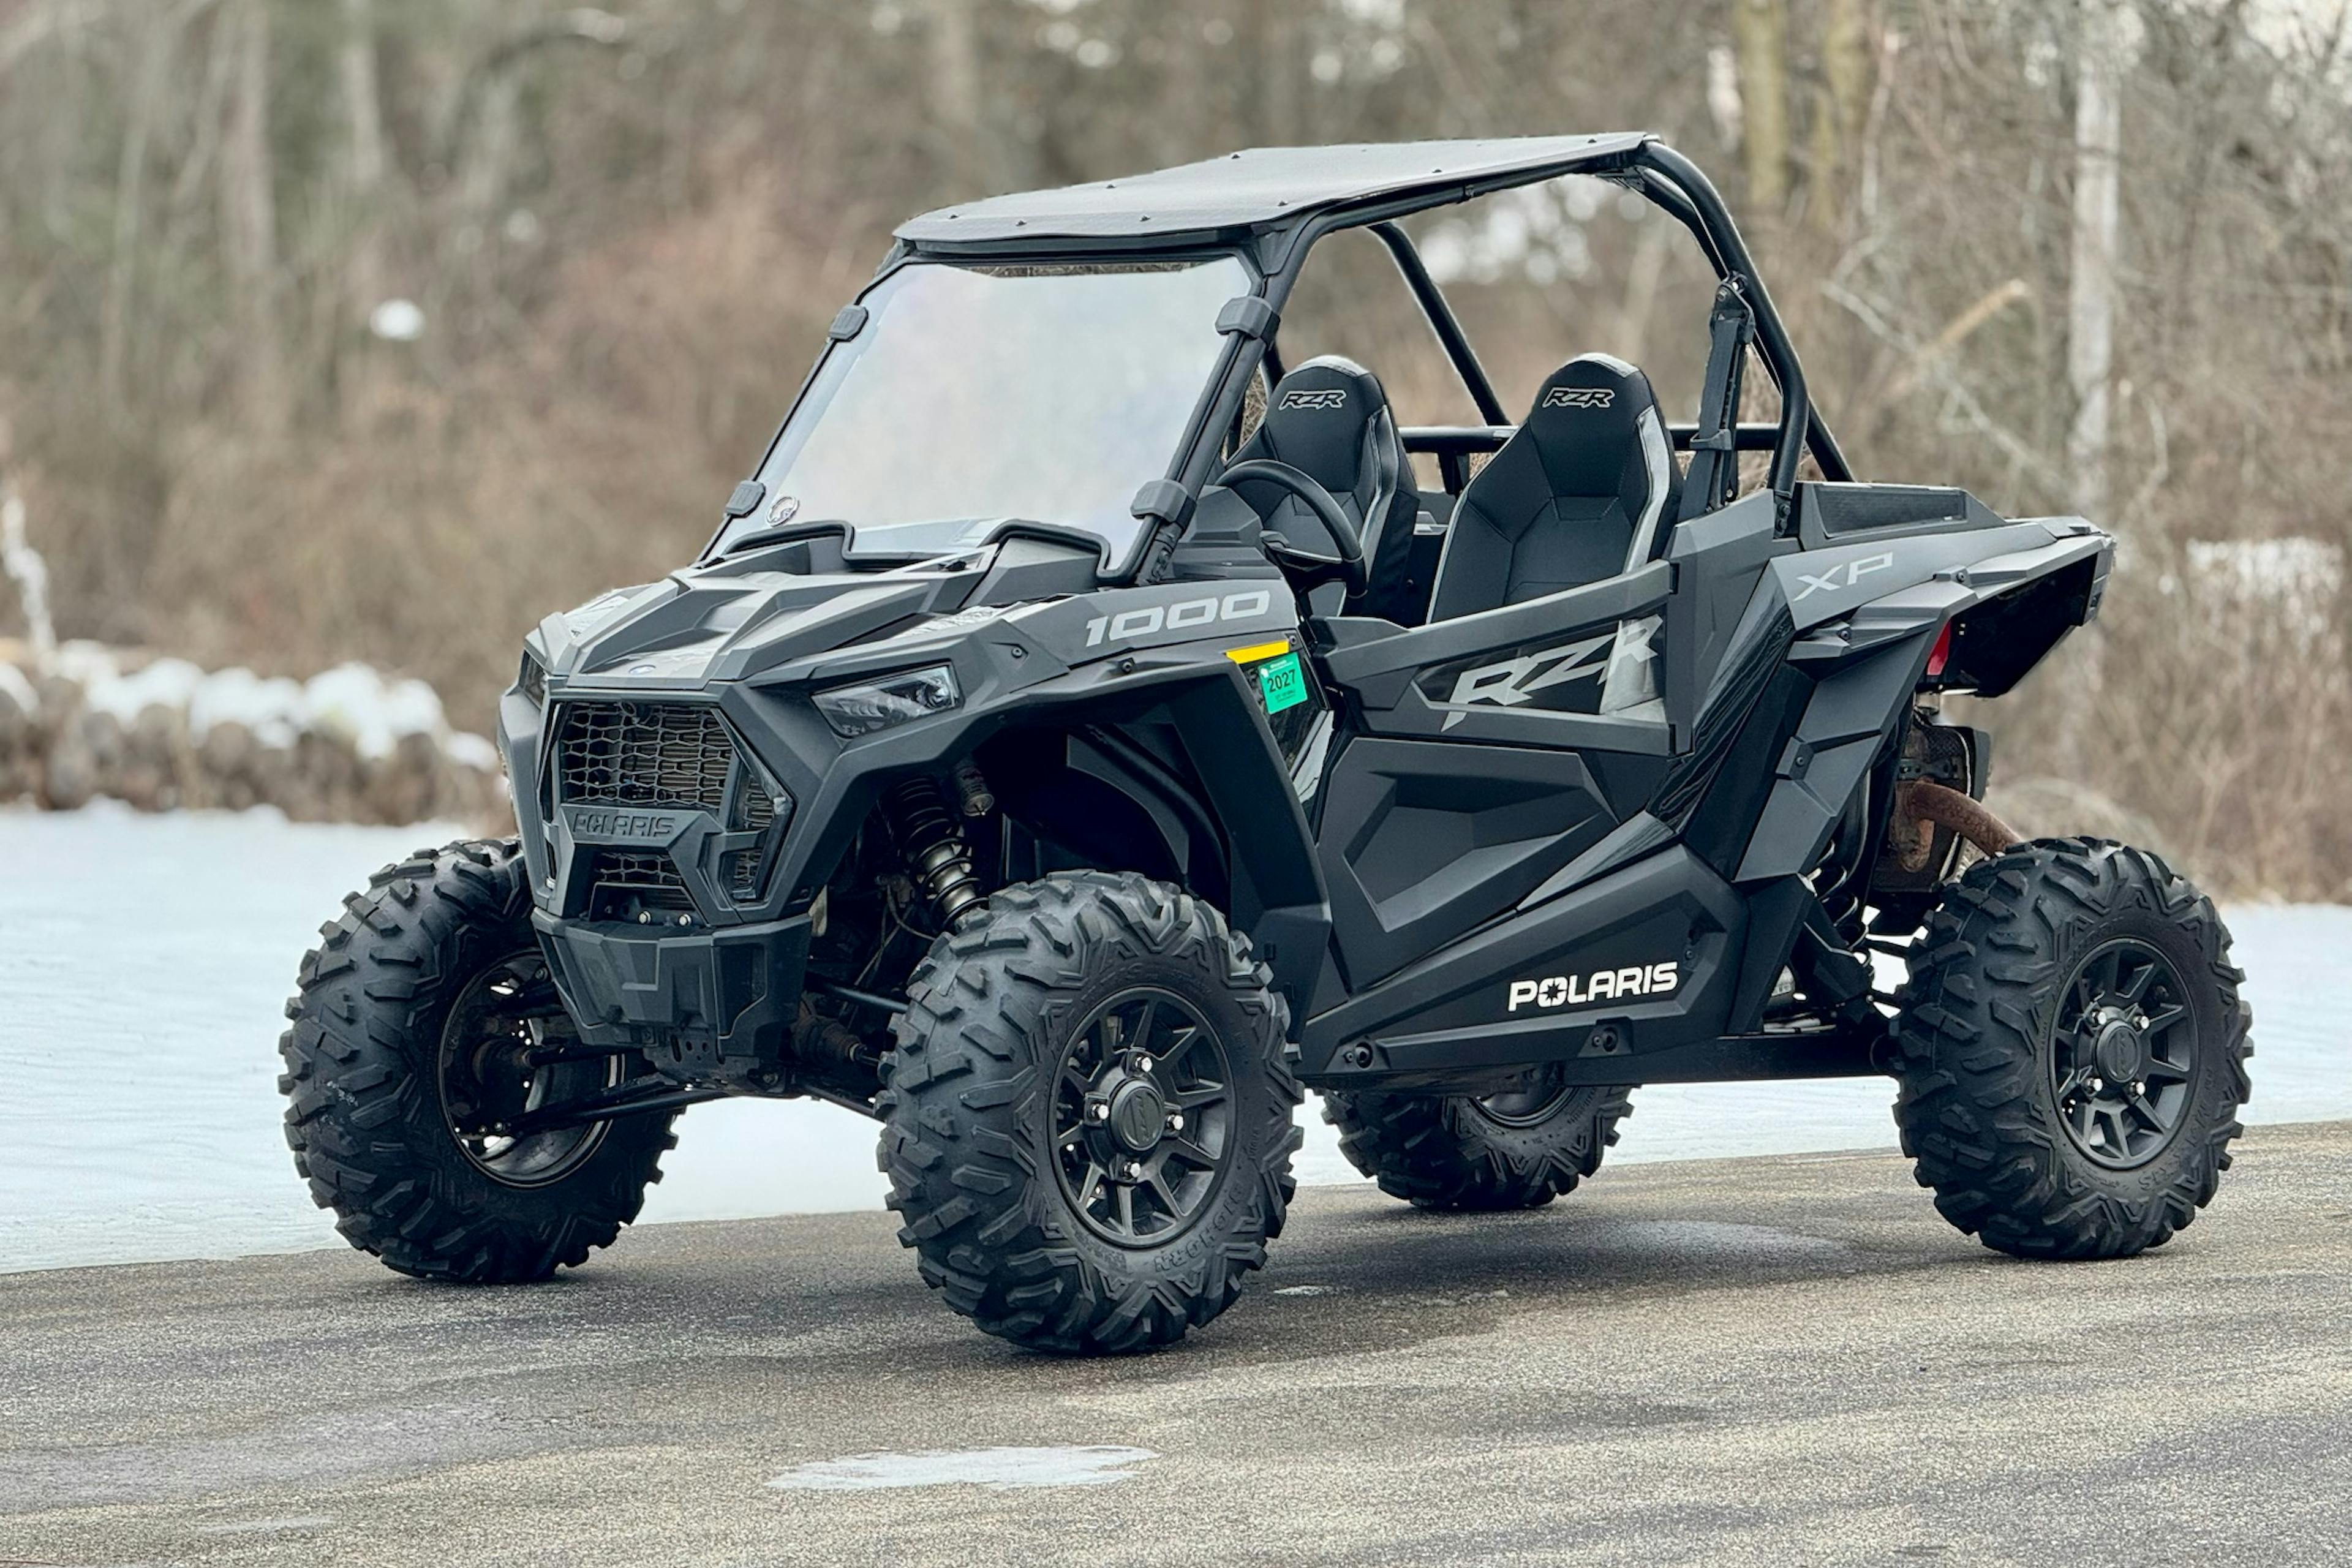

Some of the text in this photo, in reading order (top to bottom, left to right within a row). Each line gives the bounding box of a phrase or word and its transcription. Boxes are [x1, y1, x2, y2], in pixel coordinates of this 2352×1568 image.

[1278, 390, 1347, 410] RZR
[1542, 387, 1615, 408] RZR
[1793, 552, 1893, 602] XP
[1086, 590, 1270, 647] 1000
[1267, 669, 1295, 693] 2027
[1441, 615, 1664, 733] RZR
[573, 813, 676, 837] POLARIS
[1508, 962, 1678, 1012] POLARIS
